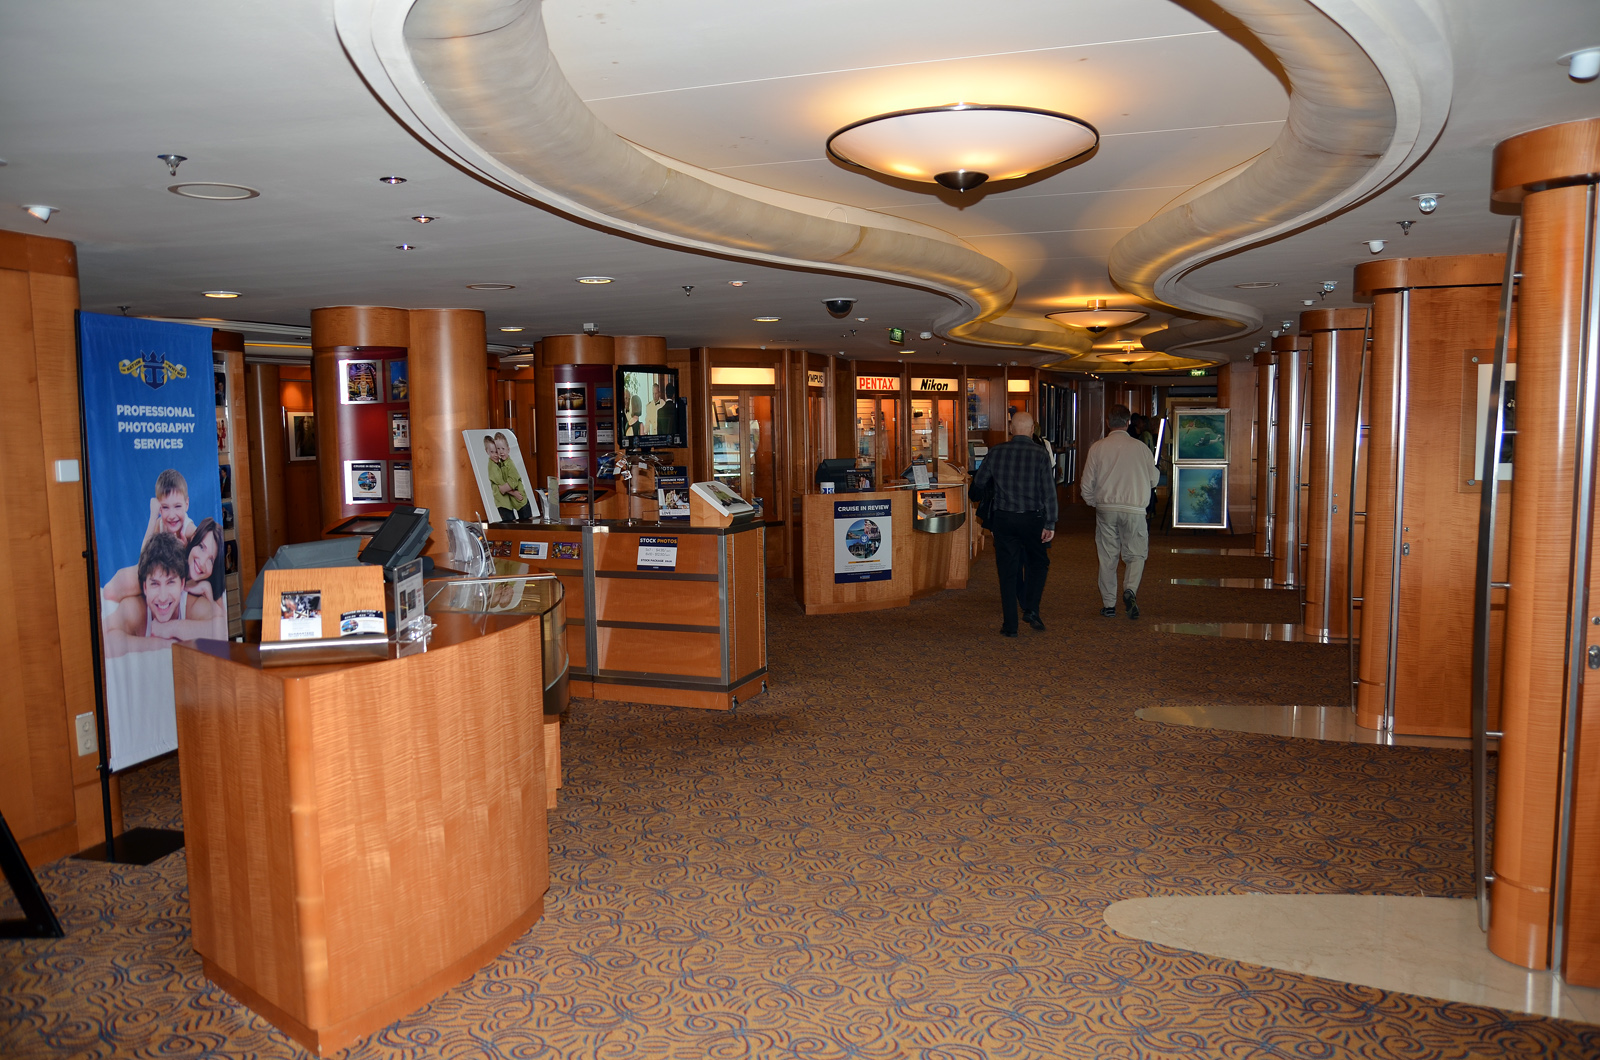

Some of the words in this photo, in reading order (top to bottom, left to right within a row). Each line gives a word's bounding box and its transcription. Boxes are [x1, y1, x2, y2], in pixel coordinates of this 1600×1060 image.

[126, 360, 142, 372] NATION
[859, 377, 894, 390] PENTAX
[920, 378, 949, 391] Nikon
[116, 404, 195, 417] PROFESSIONAL
[118, 421, 196, 434] PHOTOGRAPHY
[134, 438, 184, 450] SERVICES
